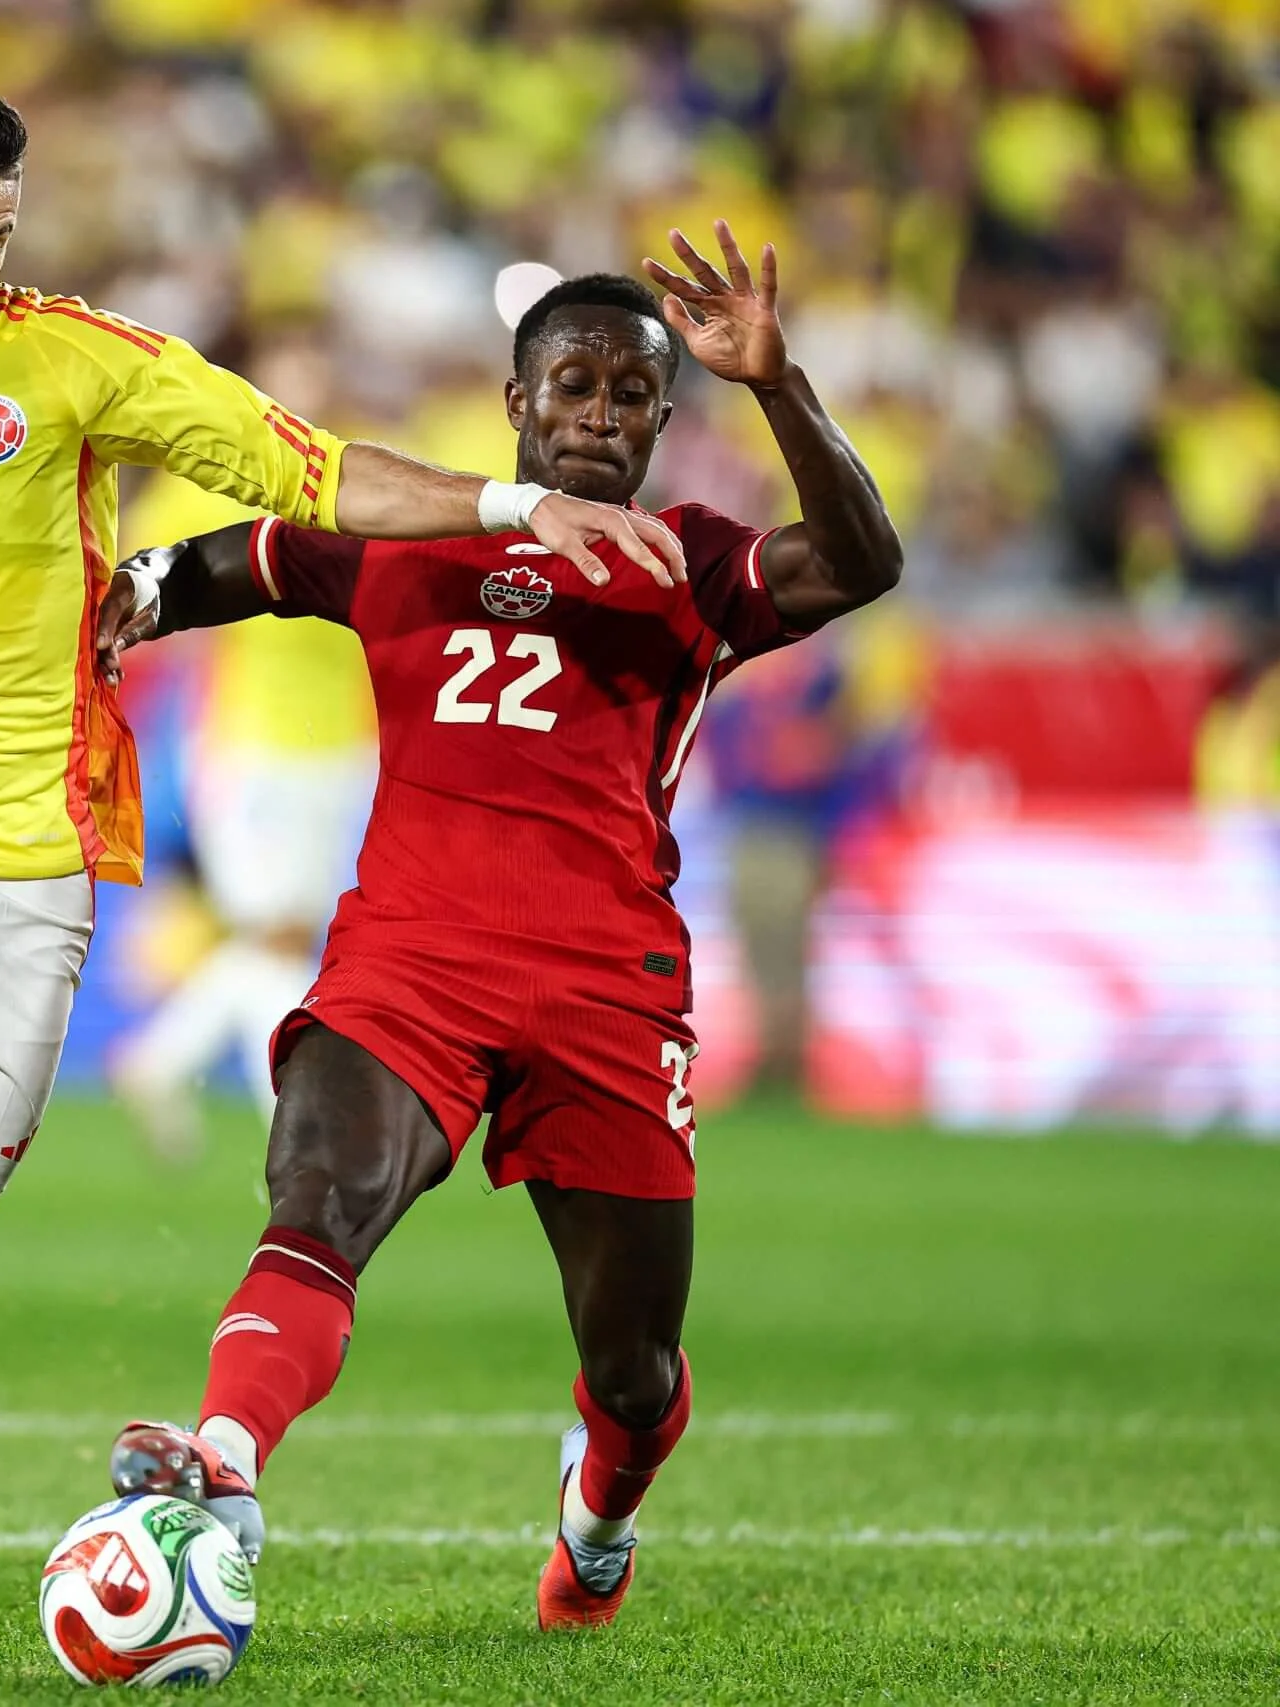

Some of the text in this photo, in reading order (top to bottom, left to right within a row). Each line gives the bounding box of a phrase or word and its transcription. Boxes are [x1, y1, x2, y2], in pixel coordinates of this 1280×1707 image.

[483, 583, 549, 602] CANADA
[433, 628, 563, 733] 22
[660, 1040, 700, 1131] 2
